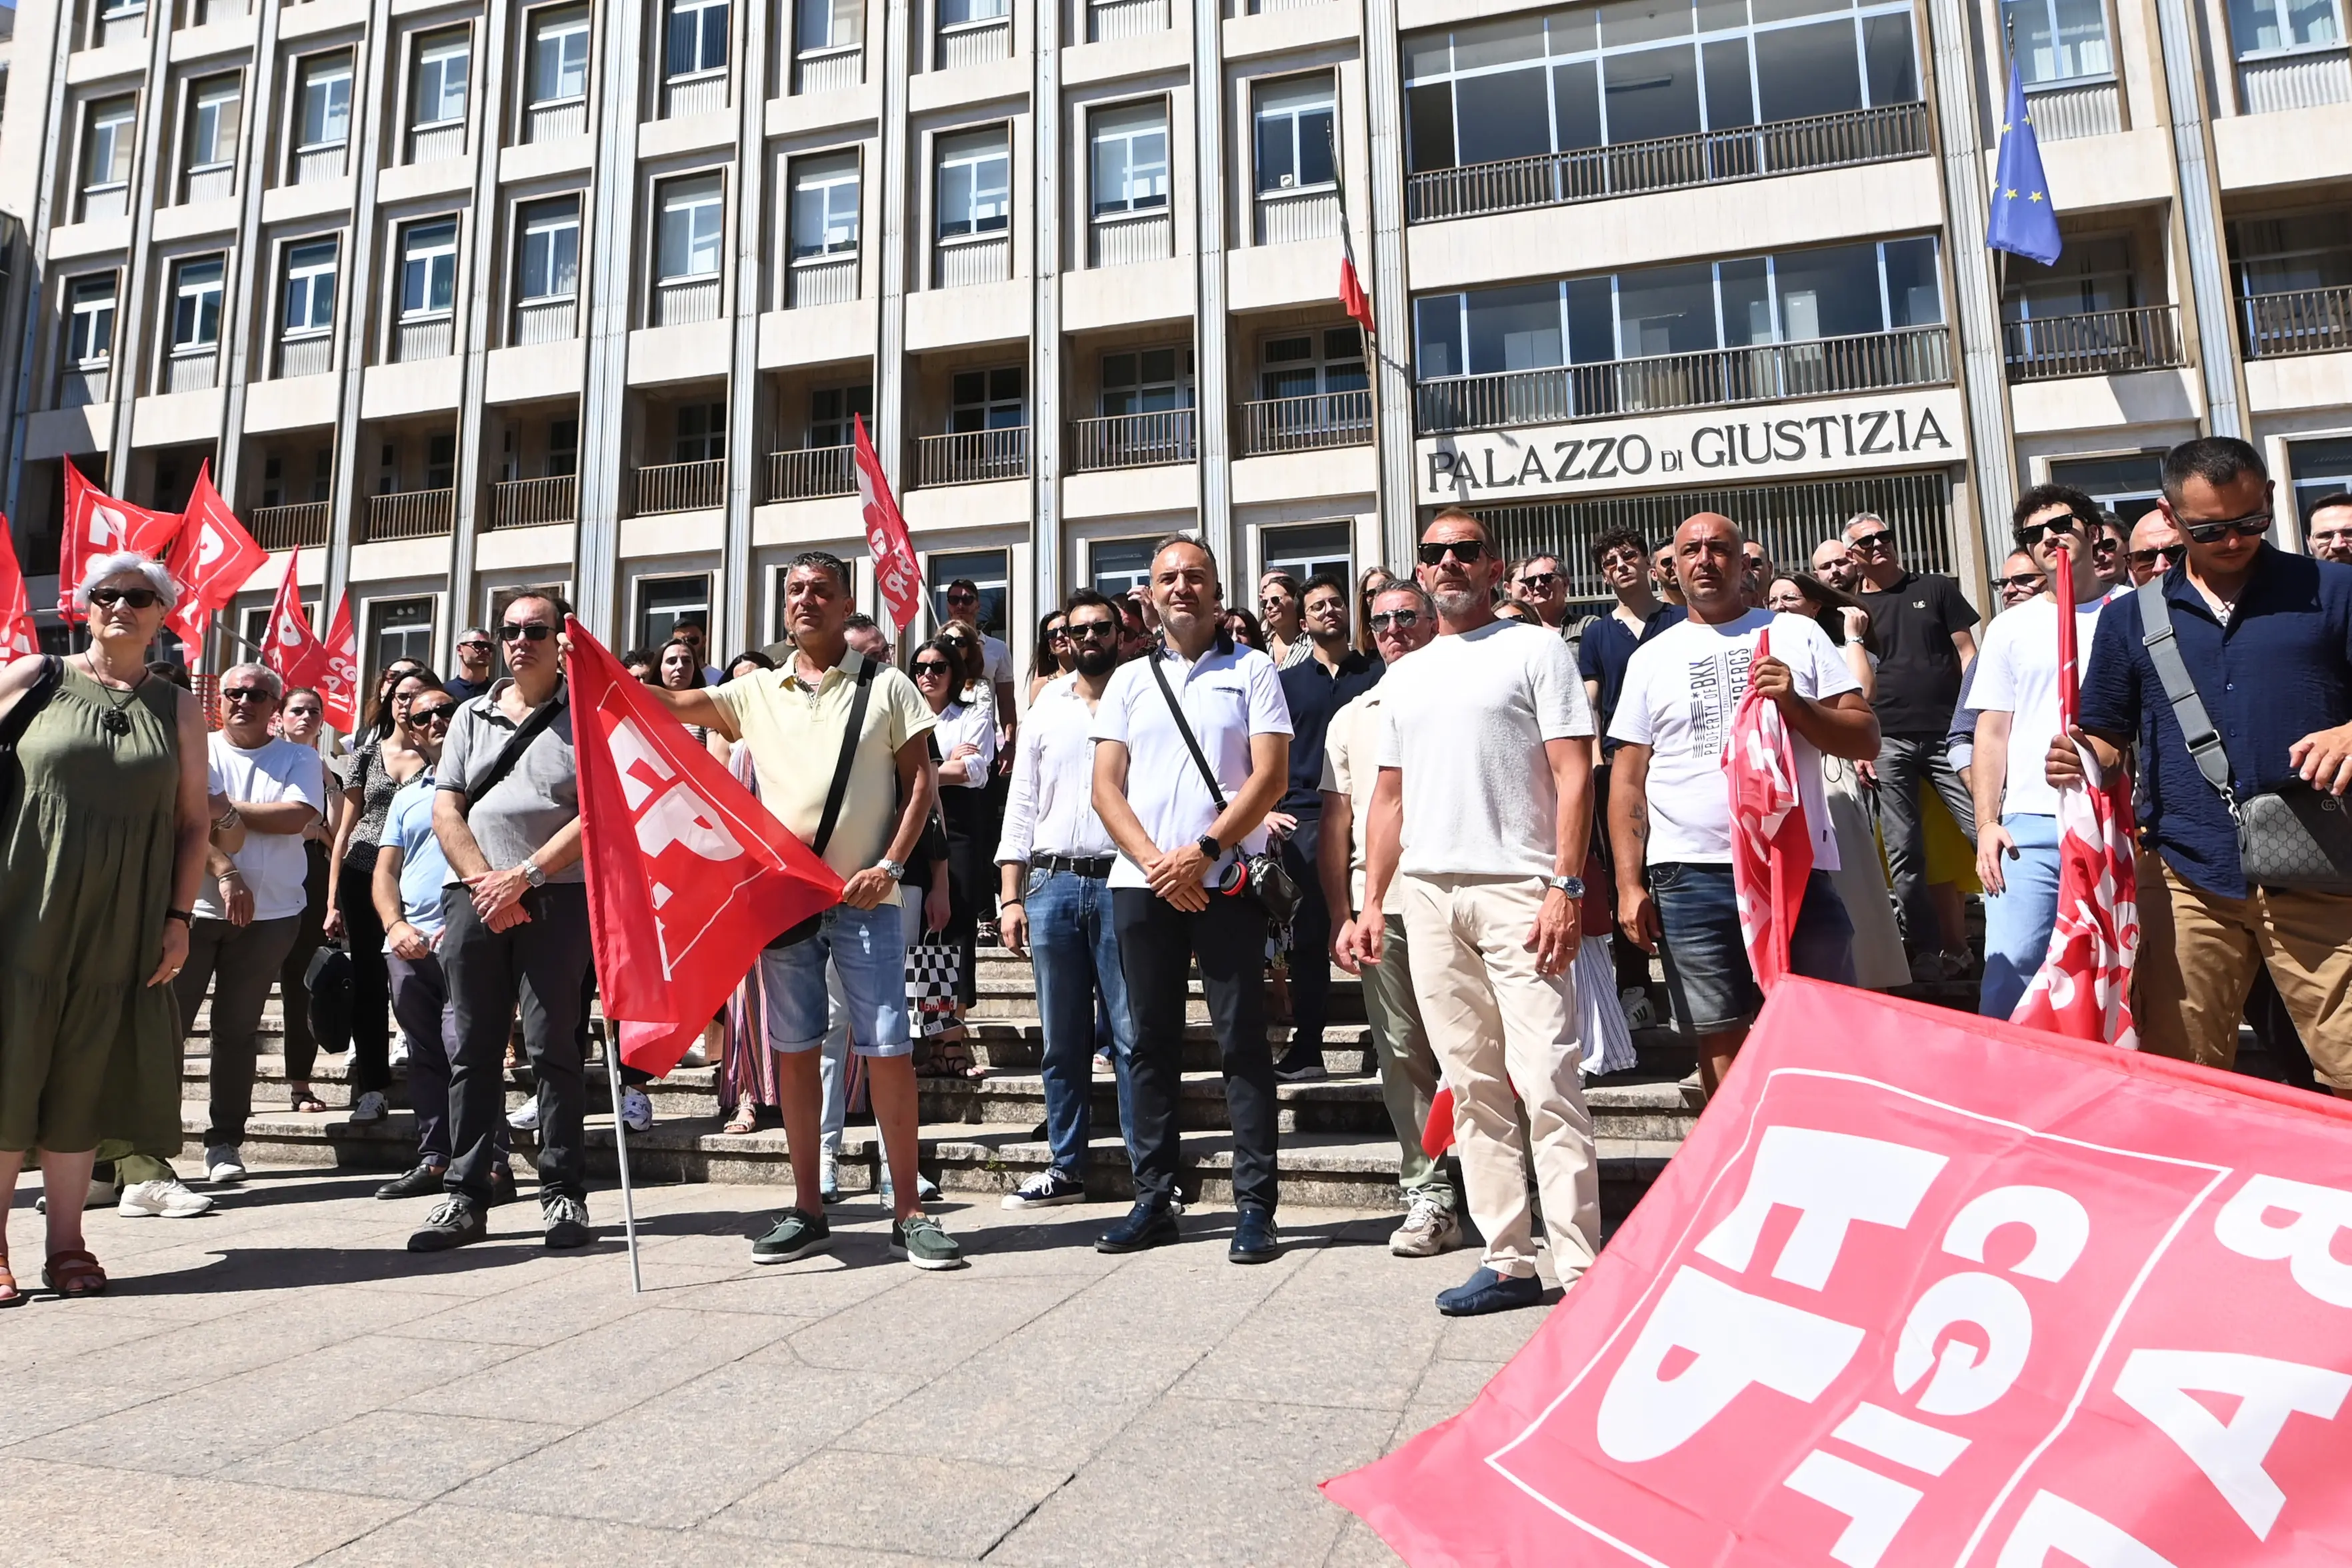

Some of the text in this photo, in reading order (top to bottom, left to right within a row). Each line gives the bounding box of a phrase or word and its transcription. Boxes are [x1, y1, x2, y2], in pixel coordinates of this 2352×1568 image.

[1427, 407, 1952, 493] PALAZZO DI GIUSTIZIA
[1689, 655, 1717, 689] BKK
